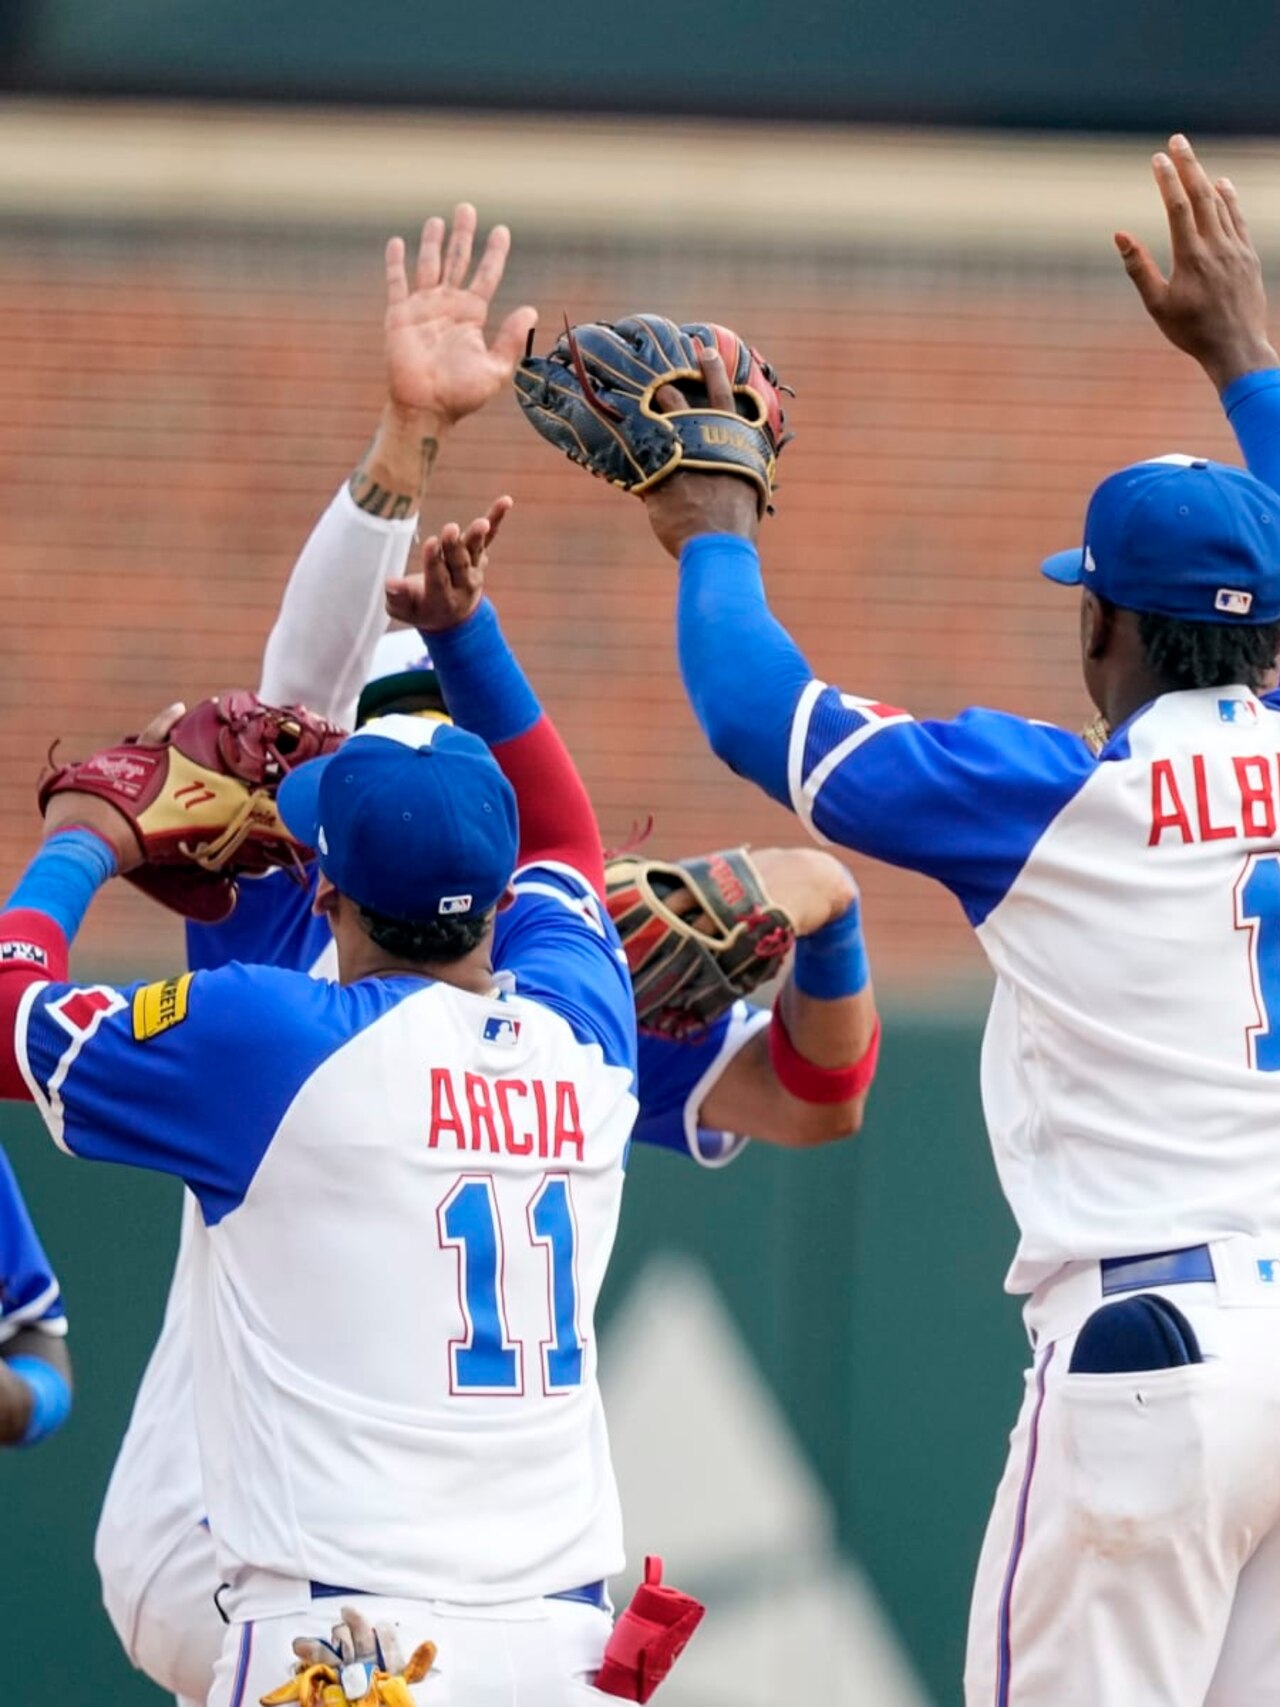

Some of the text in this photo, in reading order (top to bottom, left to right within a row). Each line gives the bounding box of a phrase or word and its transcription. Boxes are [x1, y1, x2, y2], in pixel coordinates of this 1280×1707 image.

[173, 780, 216, 811] 11
[428, 1067, 584, 1162] ARCIA
[435, 1171, 588, 1397] 11
